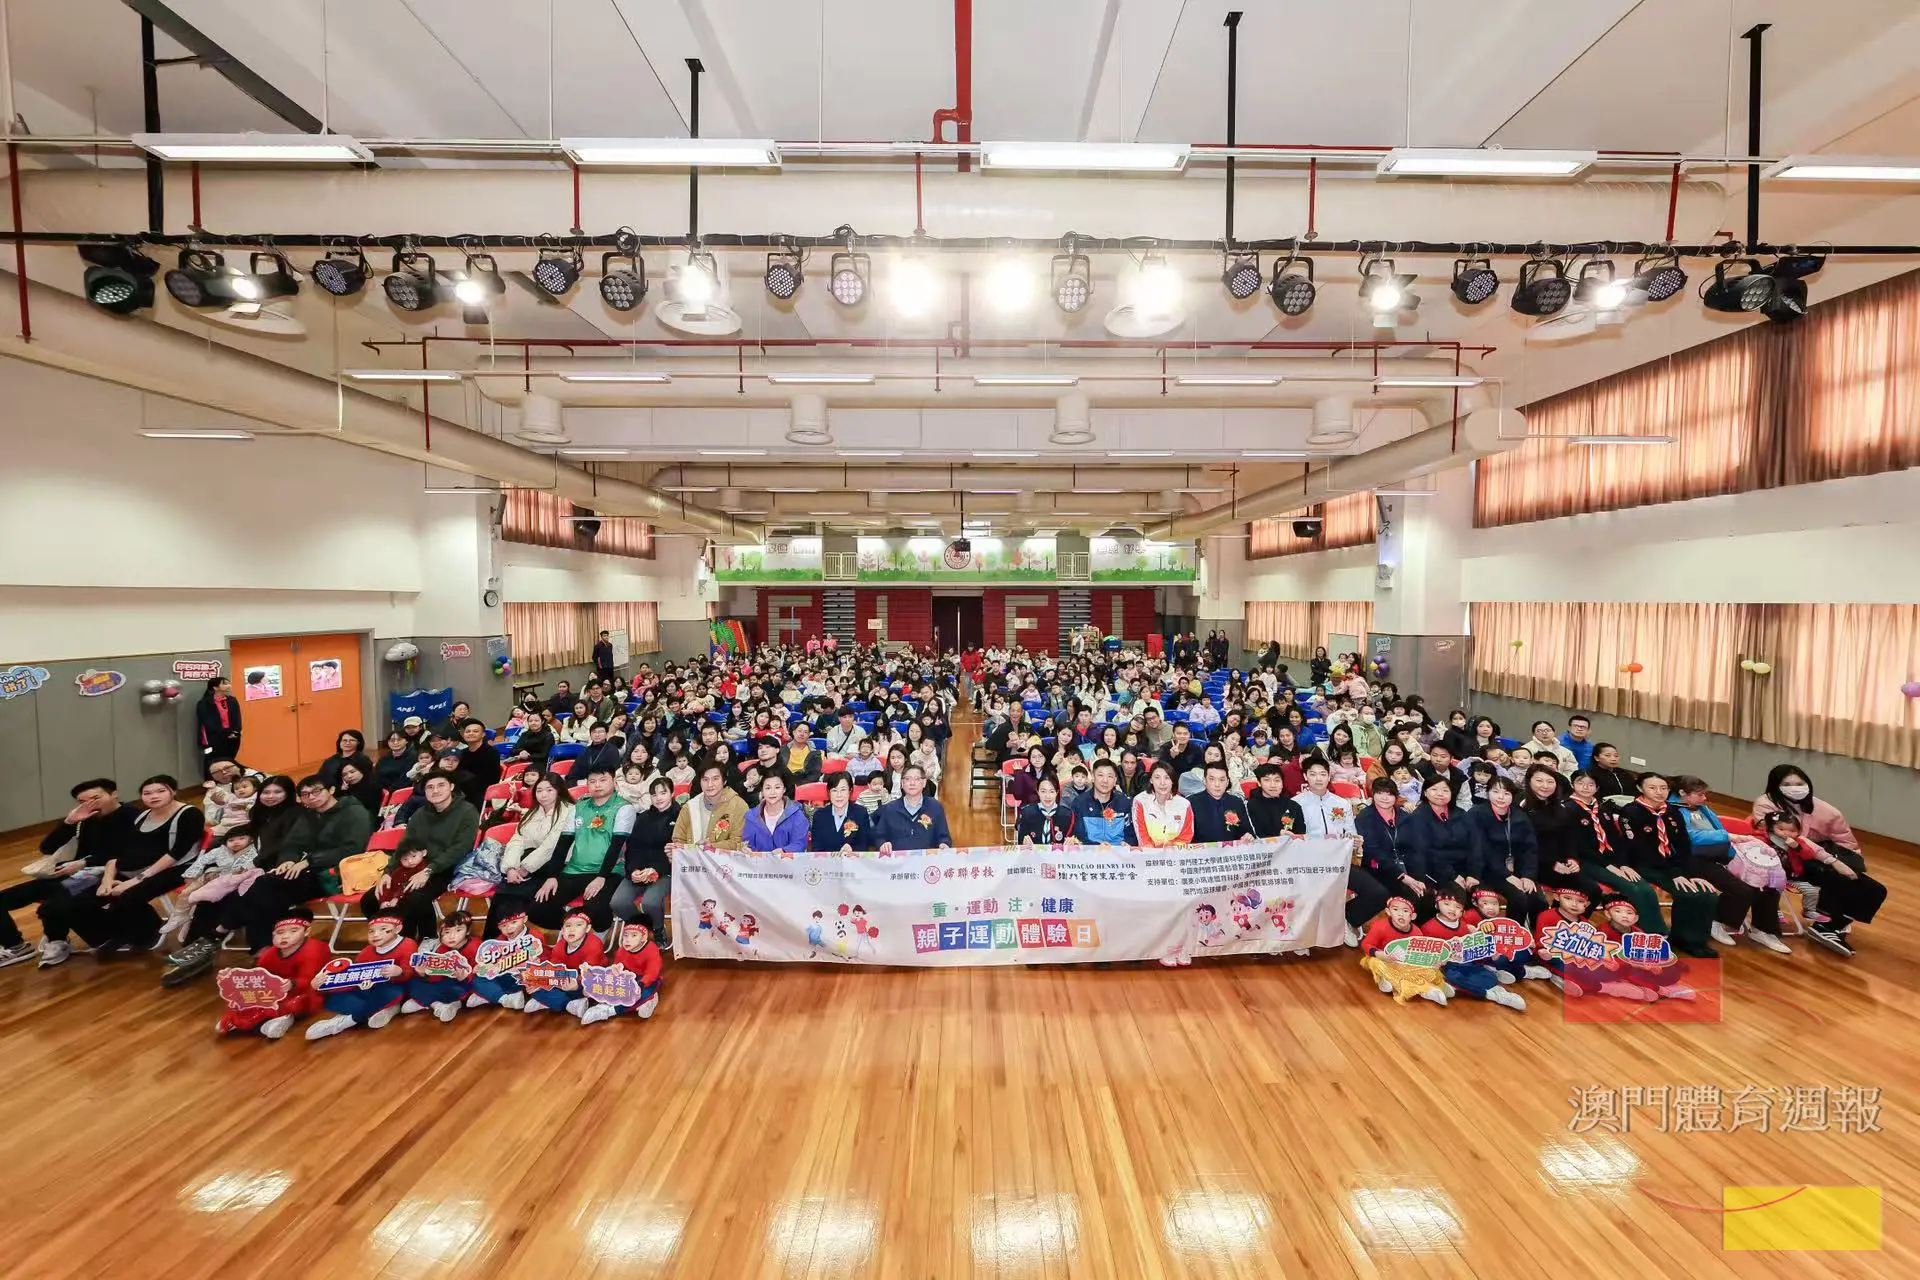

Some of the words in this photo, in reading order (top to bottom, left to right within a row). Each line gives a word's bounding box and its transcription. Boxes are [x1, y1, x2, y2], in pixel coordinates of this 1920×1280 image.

[943, 866, 995, 879] 婦聯學校
[915, 922, 1093, 949] 親子運動體驗日
[1462, 932, 1485, 947] 全民
[1632, 933, 1662, 949] 健康
[481, 937, 533, 964] Sports
[1408, 938, 1445, 954] 無限
[1462, 942, 1496, 962] 動起來
[1553, 929, 1604, 961] 全力以赴
[499, 950, 530, 972] 加油
[1629, 949, 1662, 964] 運動
